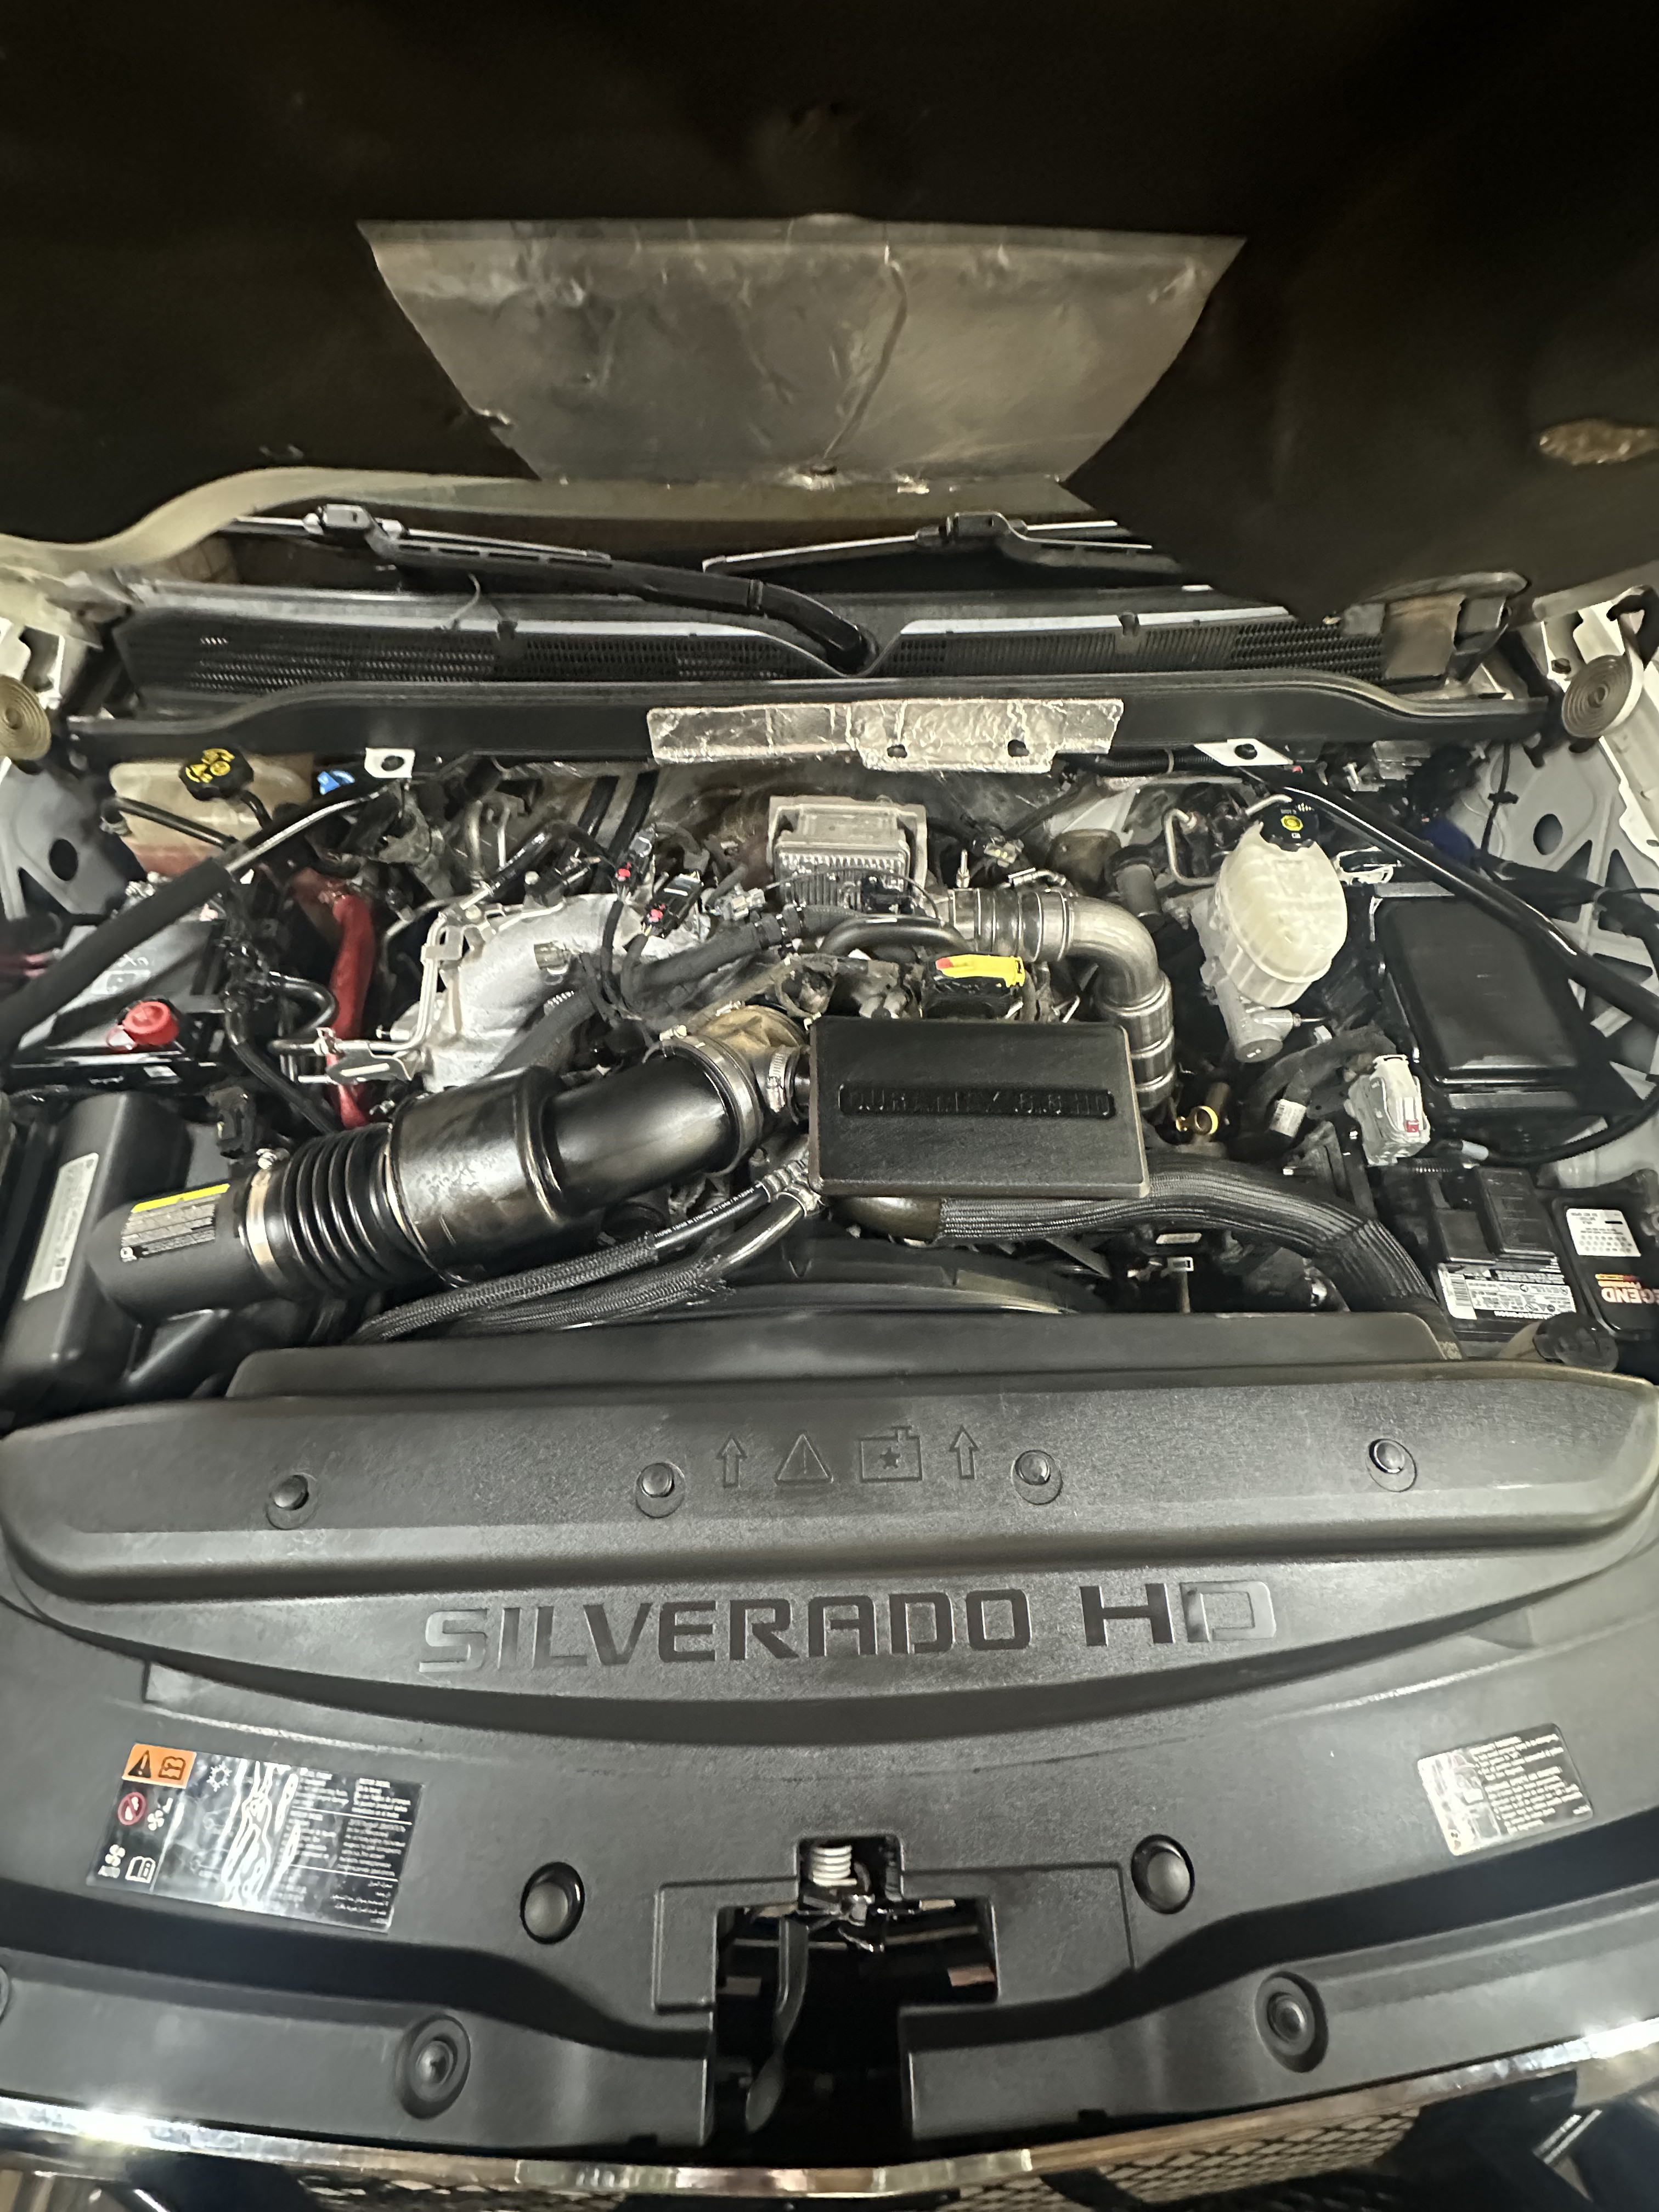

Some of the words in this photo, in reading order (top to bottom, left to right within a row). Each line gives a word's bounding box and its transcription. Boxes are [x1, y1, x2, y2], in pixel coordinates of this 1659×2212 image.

[1601, 1288, 1659, 1304] EGEND
[420, 1589, 1033, 1673] SILVERADO
[1080, 1579, 1277, 1646] HD
